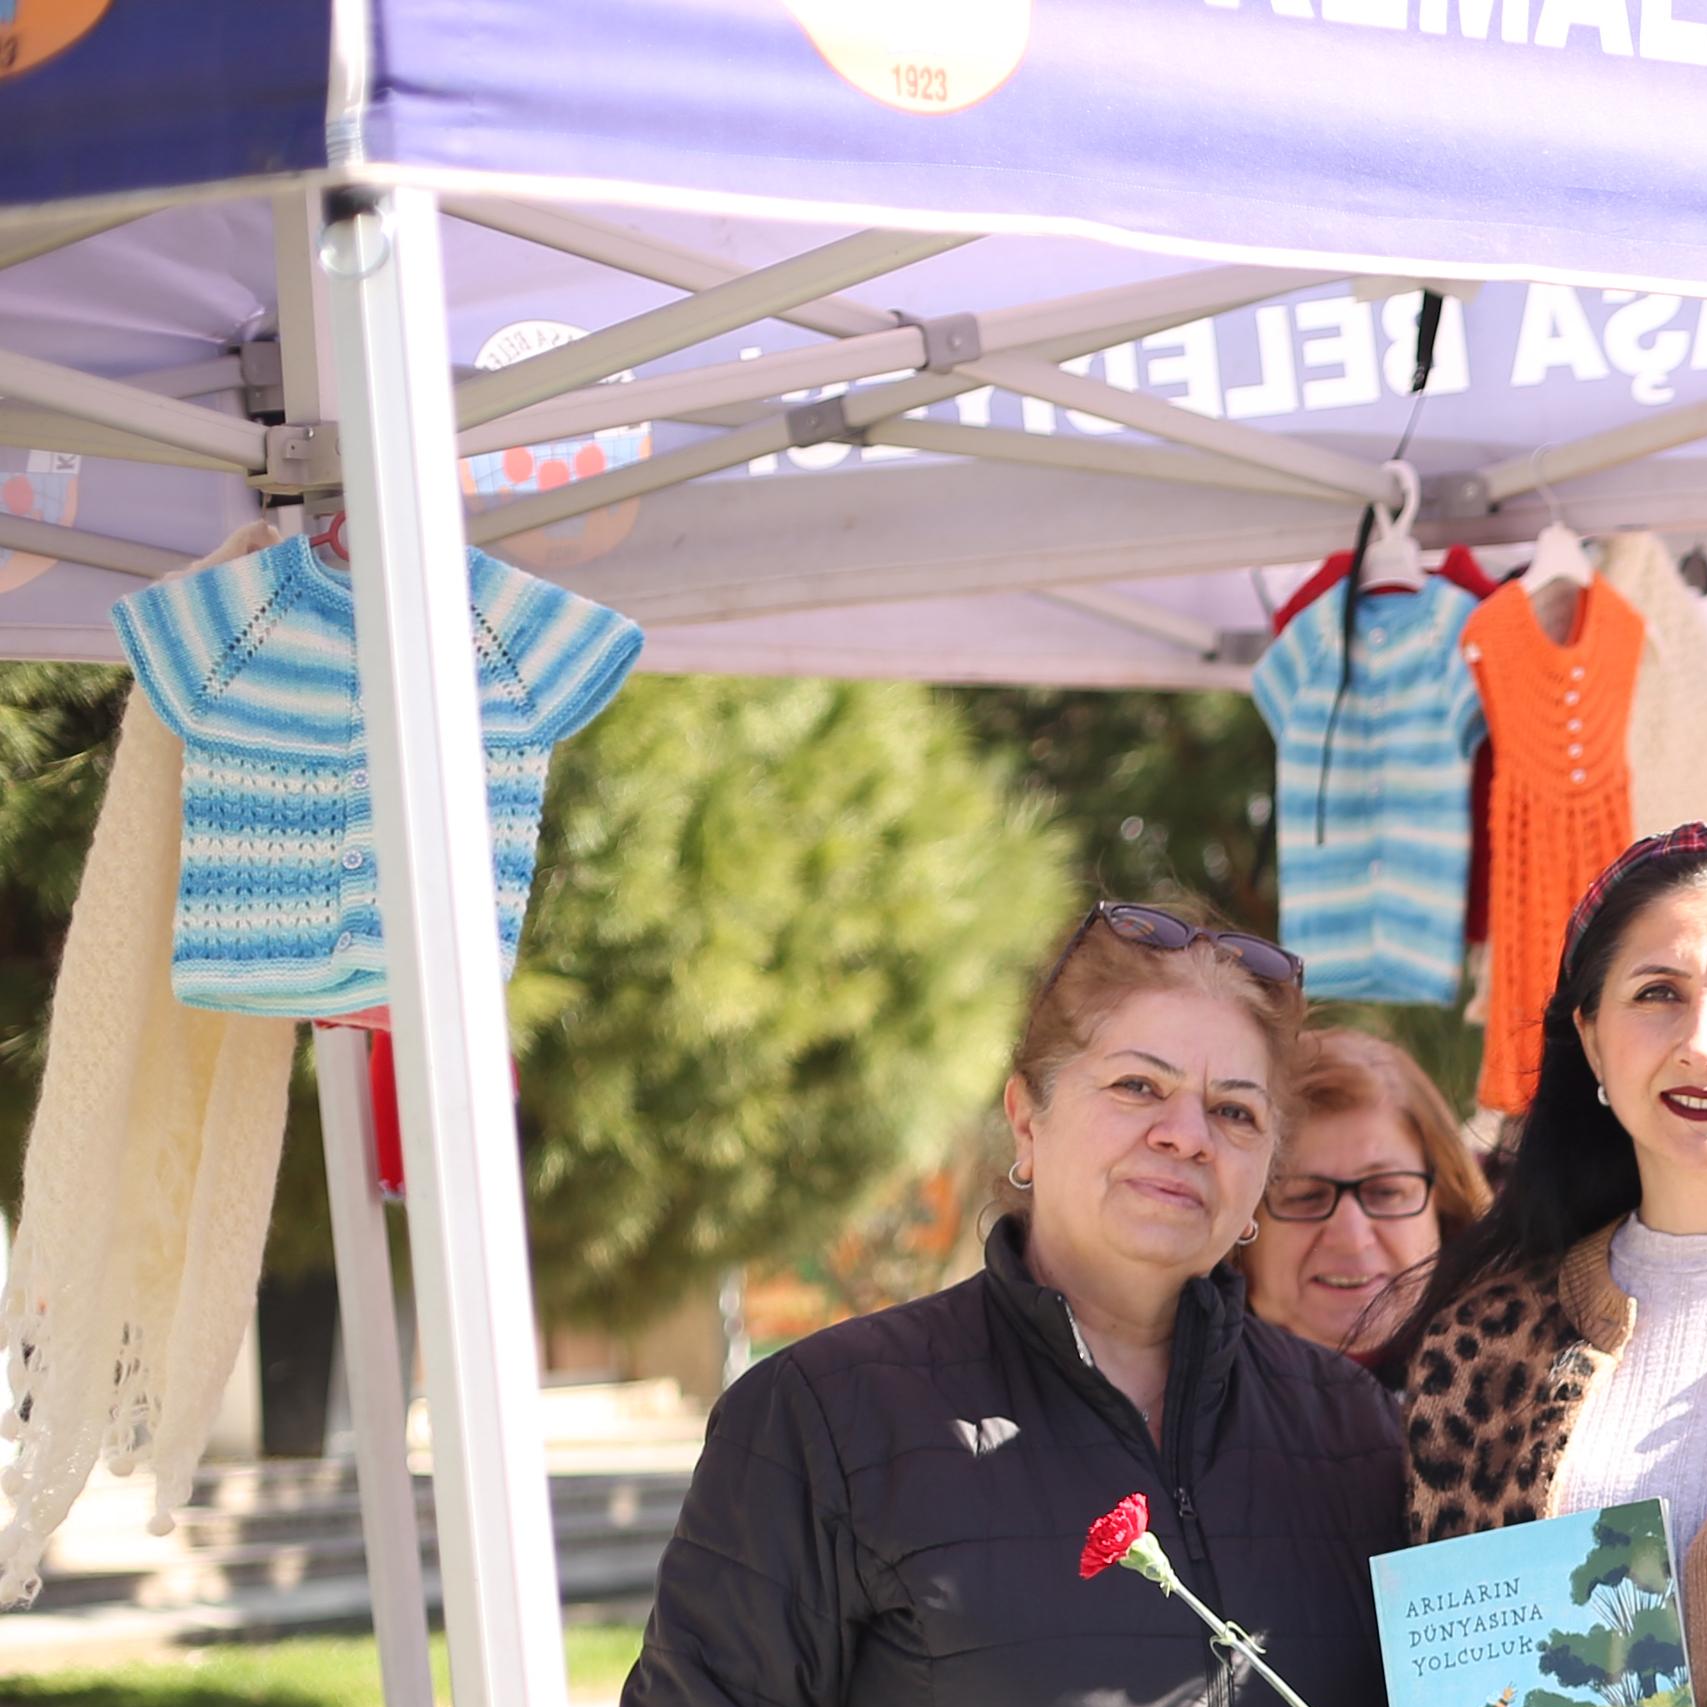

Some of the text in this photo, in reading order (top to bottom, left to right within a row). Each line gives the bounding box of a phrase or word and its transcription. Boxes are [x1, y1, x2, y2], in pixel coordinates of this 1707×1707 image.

[891, 63, 948, 102] 1923
[1406, 1577, 1520, 1618] ARILARIN
[1408, 1604, 1543, 1648] DÜNYASINA
[1412, 1635, 1533, 1677] YOLCULUK
